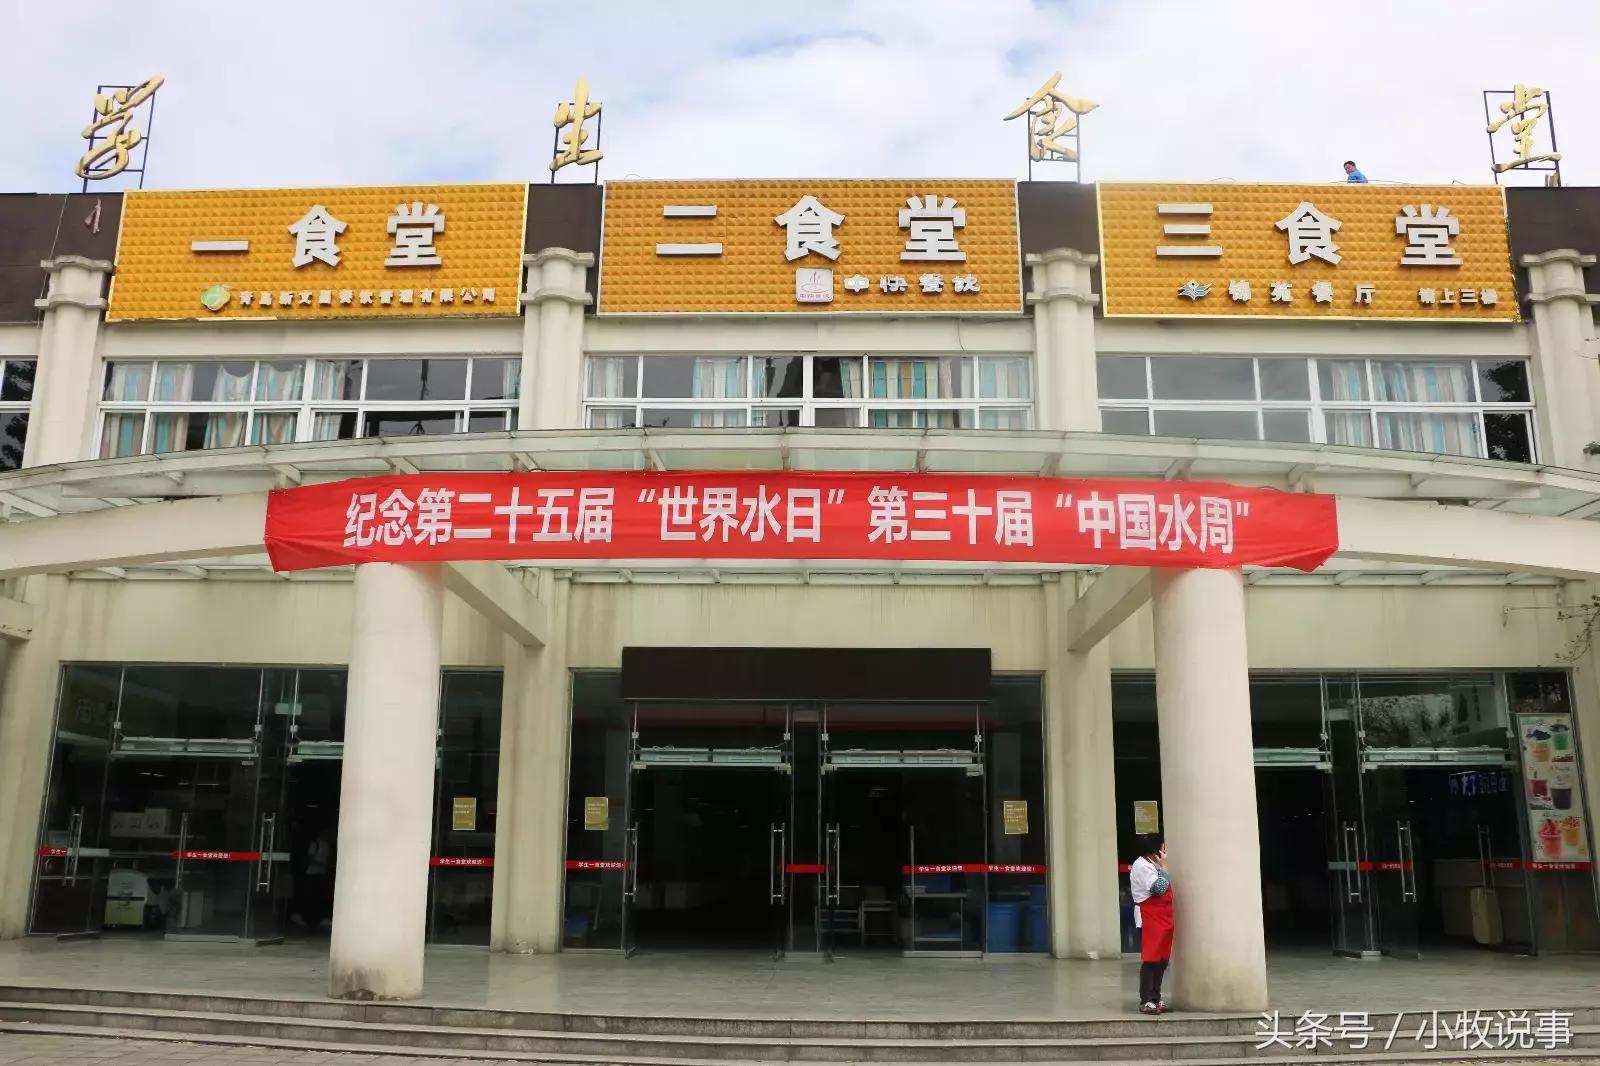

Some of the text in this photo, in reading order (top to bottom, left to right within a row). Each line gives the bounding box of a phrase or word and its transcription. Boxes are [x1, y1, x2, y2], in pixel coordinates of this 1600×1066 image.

[75, 70, 1562, 179] 学 生 食 堂
[191, 201, 446, 268] 一食堂
[655, 194, 967, 262] 二食堂
[1156, 200, 1464, 267] 三食堂
[843, 273, 981, 294] 中快餐饮
